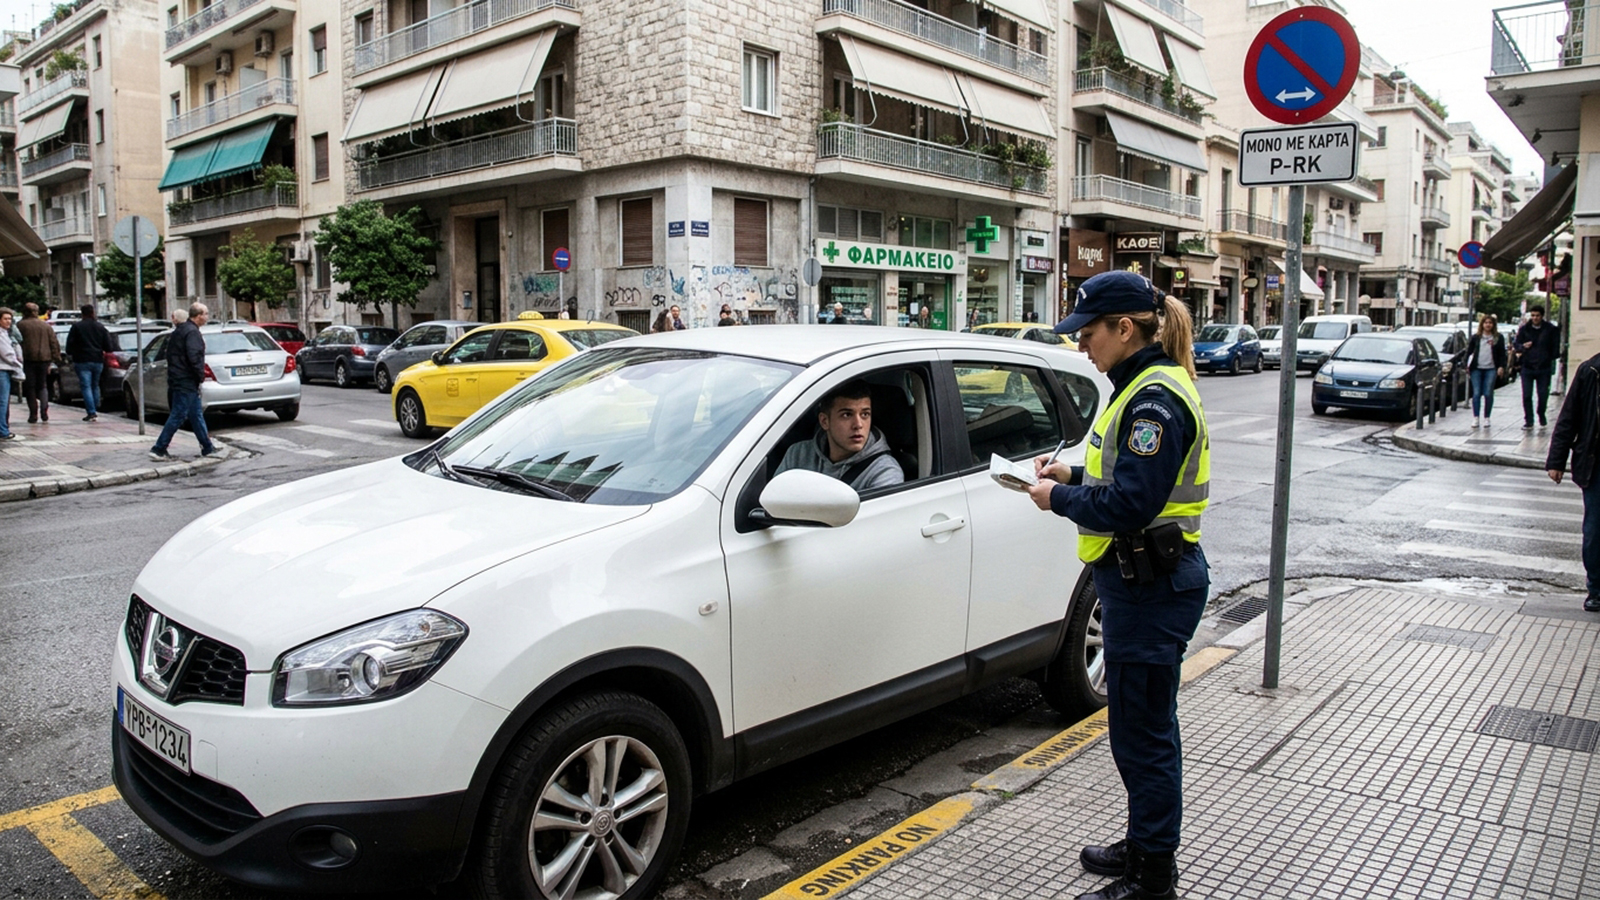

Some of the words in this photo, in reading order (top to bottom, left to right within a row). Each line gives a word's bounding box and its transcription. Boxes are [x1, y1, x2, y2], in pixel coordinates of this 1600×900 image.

[1246, 137, 1282, 153] ΜΟΝΟ
[1286, 136, 1304, 150] ΜΕ
[1308, 132, 1349, 149] ΚΑΡΤΑ
[1270, 154, 1322, 175] P-RK
[847, 246, 954, 270] ΦΑΡΜΑΚΕΙΟ
[895, 823, 938, 843] NO
[800, 840, 909, 897] PARKING
